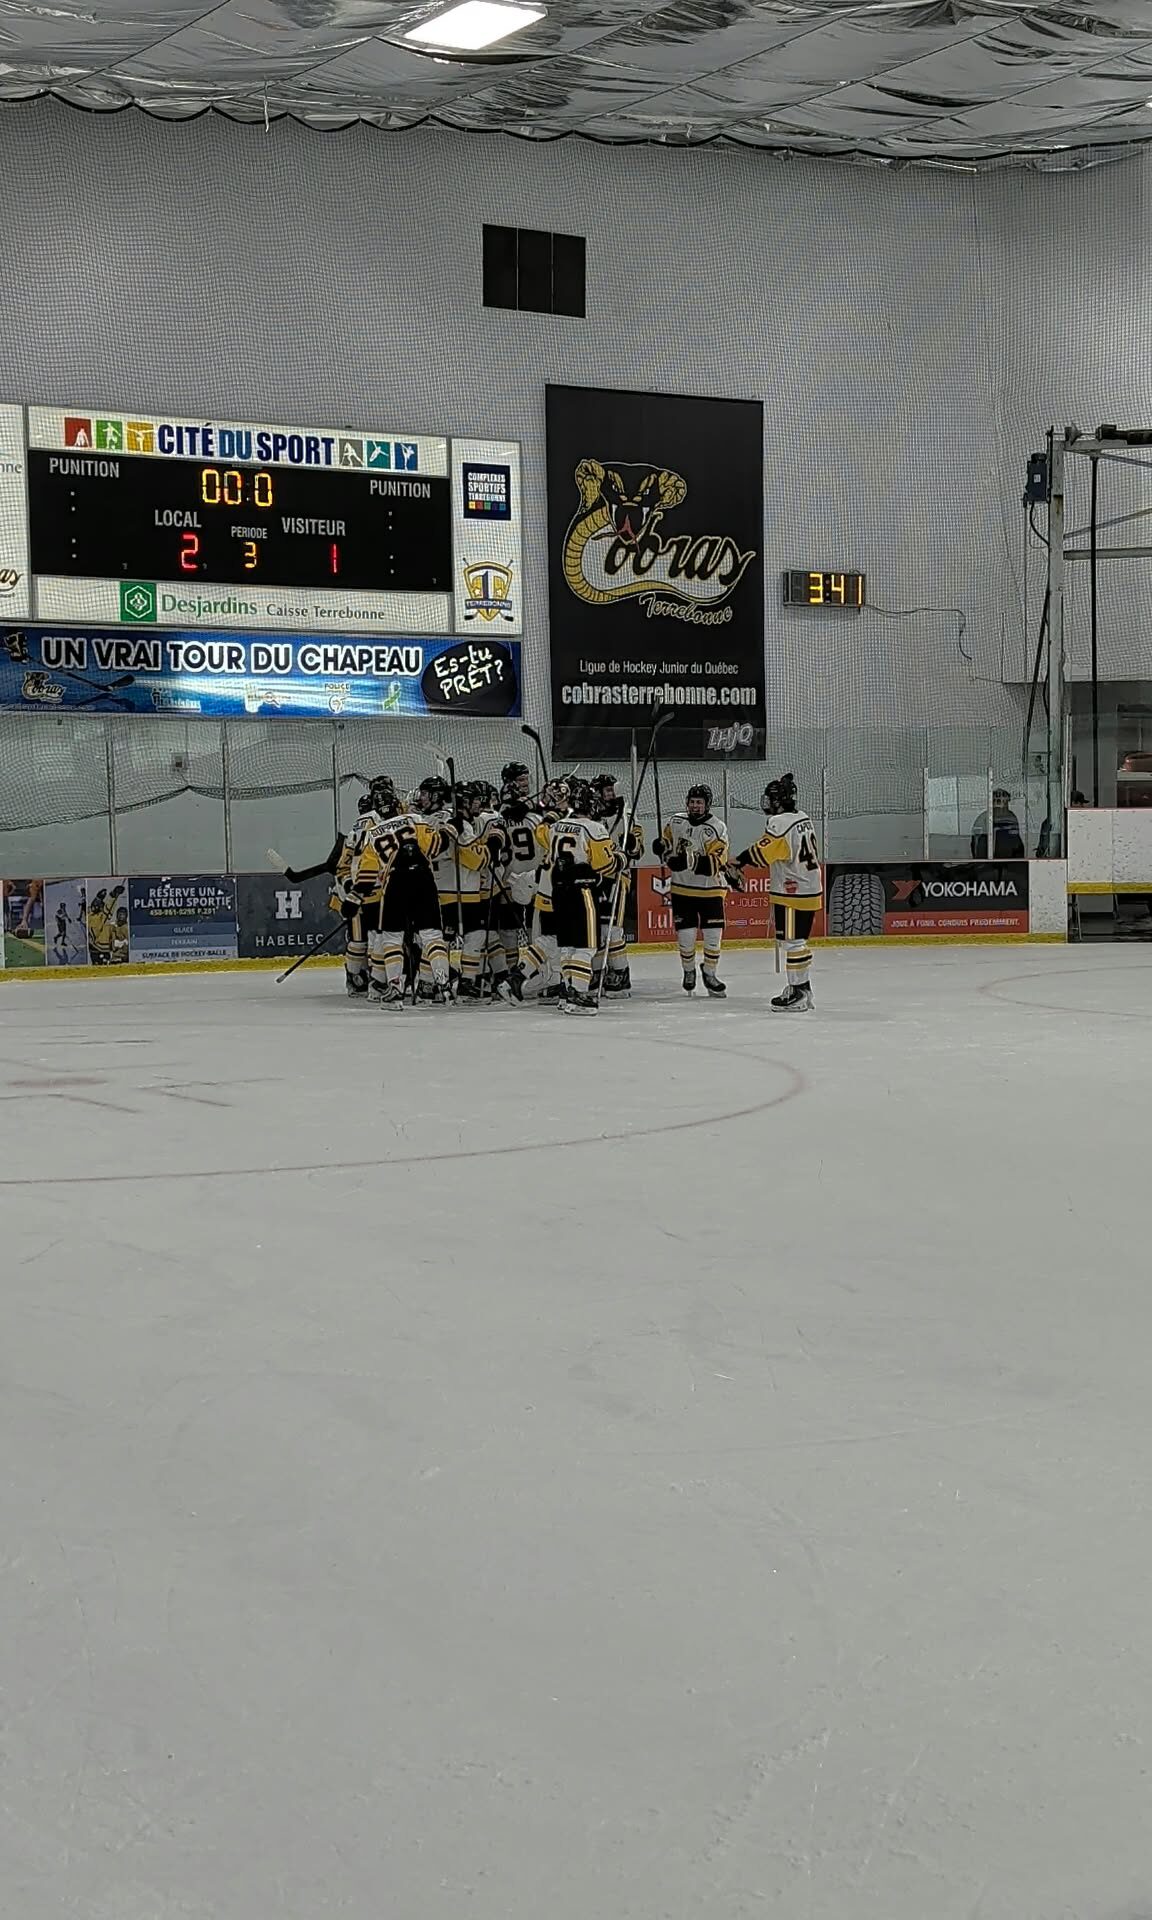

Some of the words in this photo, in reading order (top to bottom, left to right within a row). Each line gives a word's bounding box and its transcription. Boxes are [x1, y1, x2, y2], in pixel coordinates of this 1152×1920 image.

[158, 423, 215, 457] CITÉ
[218, 428, 252, 460] DU
[256, 431, 335, 466] SPORT
[49, 457, 120, 479] PUNITION
[370, 479, 431, 499] PUNITION
[468, 482, 507, 494] SPORTIFS
[154, 509, 202, 528] LOCAL
[281, 516, 346, 537] VISITEUR
[231, 526, 268, 540] PERIODE
[180, 533, 200, 569] 2
[244, 541, 257, 569] 3
[331, 543, 339, 574] 1
[161, 593, 258, 617] Desjardins
[266, 603, 309, 617] Caisse
[314, 605, 386, 621] Terrebonne
[639, 592, 733, 626] Terrebonne
[41, 637, 88, 671] UN
[92, 639, 163, 673] VRAI
[167, 640, 246, 674] TOUR
[251, 643, 293, 674] DU
[298, 645, 423, 676] CHAPEAU
[434, 645, 493, 678] Es-tu
[580, 659, 607, 675] Ligue
[609, 660, 621, 673] de
[623, 660, 657, 676] Hockey
[660, 661, 689, 675] Junior
[691, 661, 702, 675] du
[705, 660, 739, 675] Québec
[440, 660, 504, 700] PRÊT?
[562, 683, 757, 706] cobrasterrebonne.com
[149, 885, 196, 898] RÉSERVE
[198, 886, 216, 897] UN
[921, 880, 1018, 897] YOKOHAMA
[134, 897, 183, 909] PLATEAU
[186, 896, 231, 908] SPORTIF
[274, 890, 303, 920] H
[737, 898, 769, 908] JOUETS
